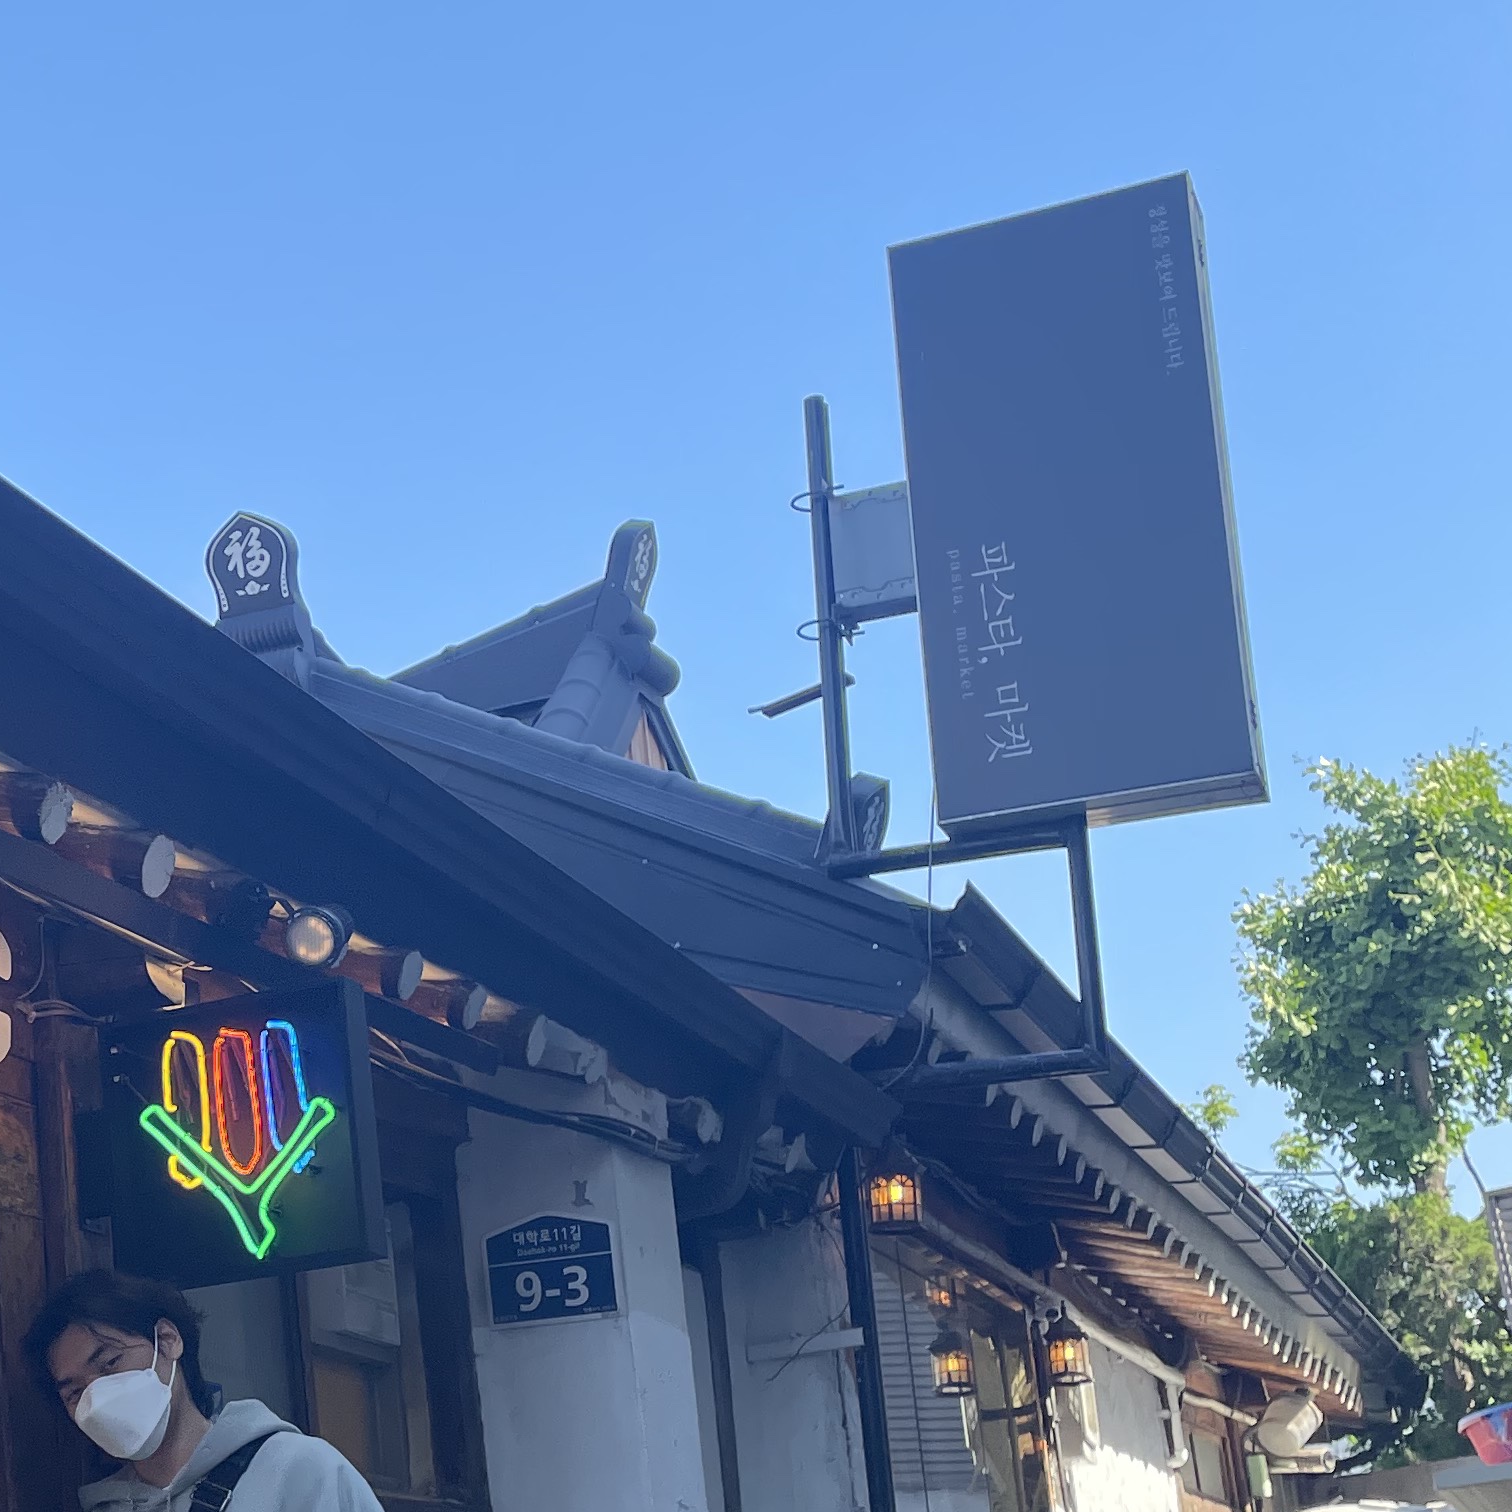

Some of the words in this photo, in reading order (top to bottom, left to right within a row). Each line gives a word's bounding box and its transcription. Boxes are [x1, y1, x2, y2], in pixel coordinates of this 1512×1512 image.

[970, 541, 1023, 665] 파스타,
[955, 626, 976, 700] market
[983, 680, 1034, 763] 마켓
[512, 1224, 582, 1246] 대학로11길
[515, 1265, 590, 1312] 9-3
